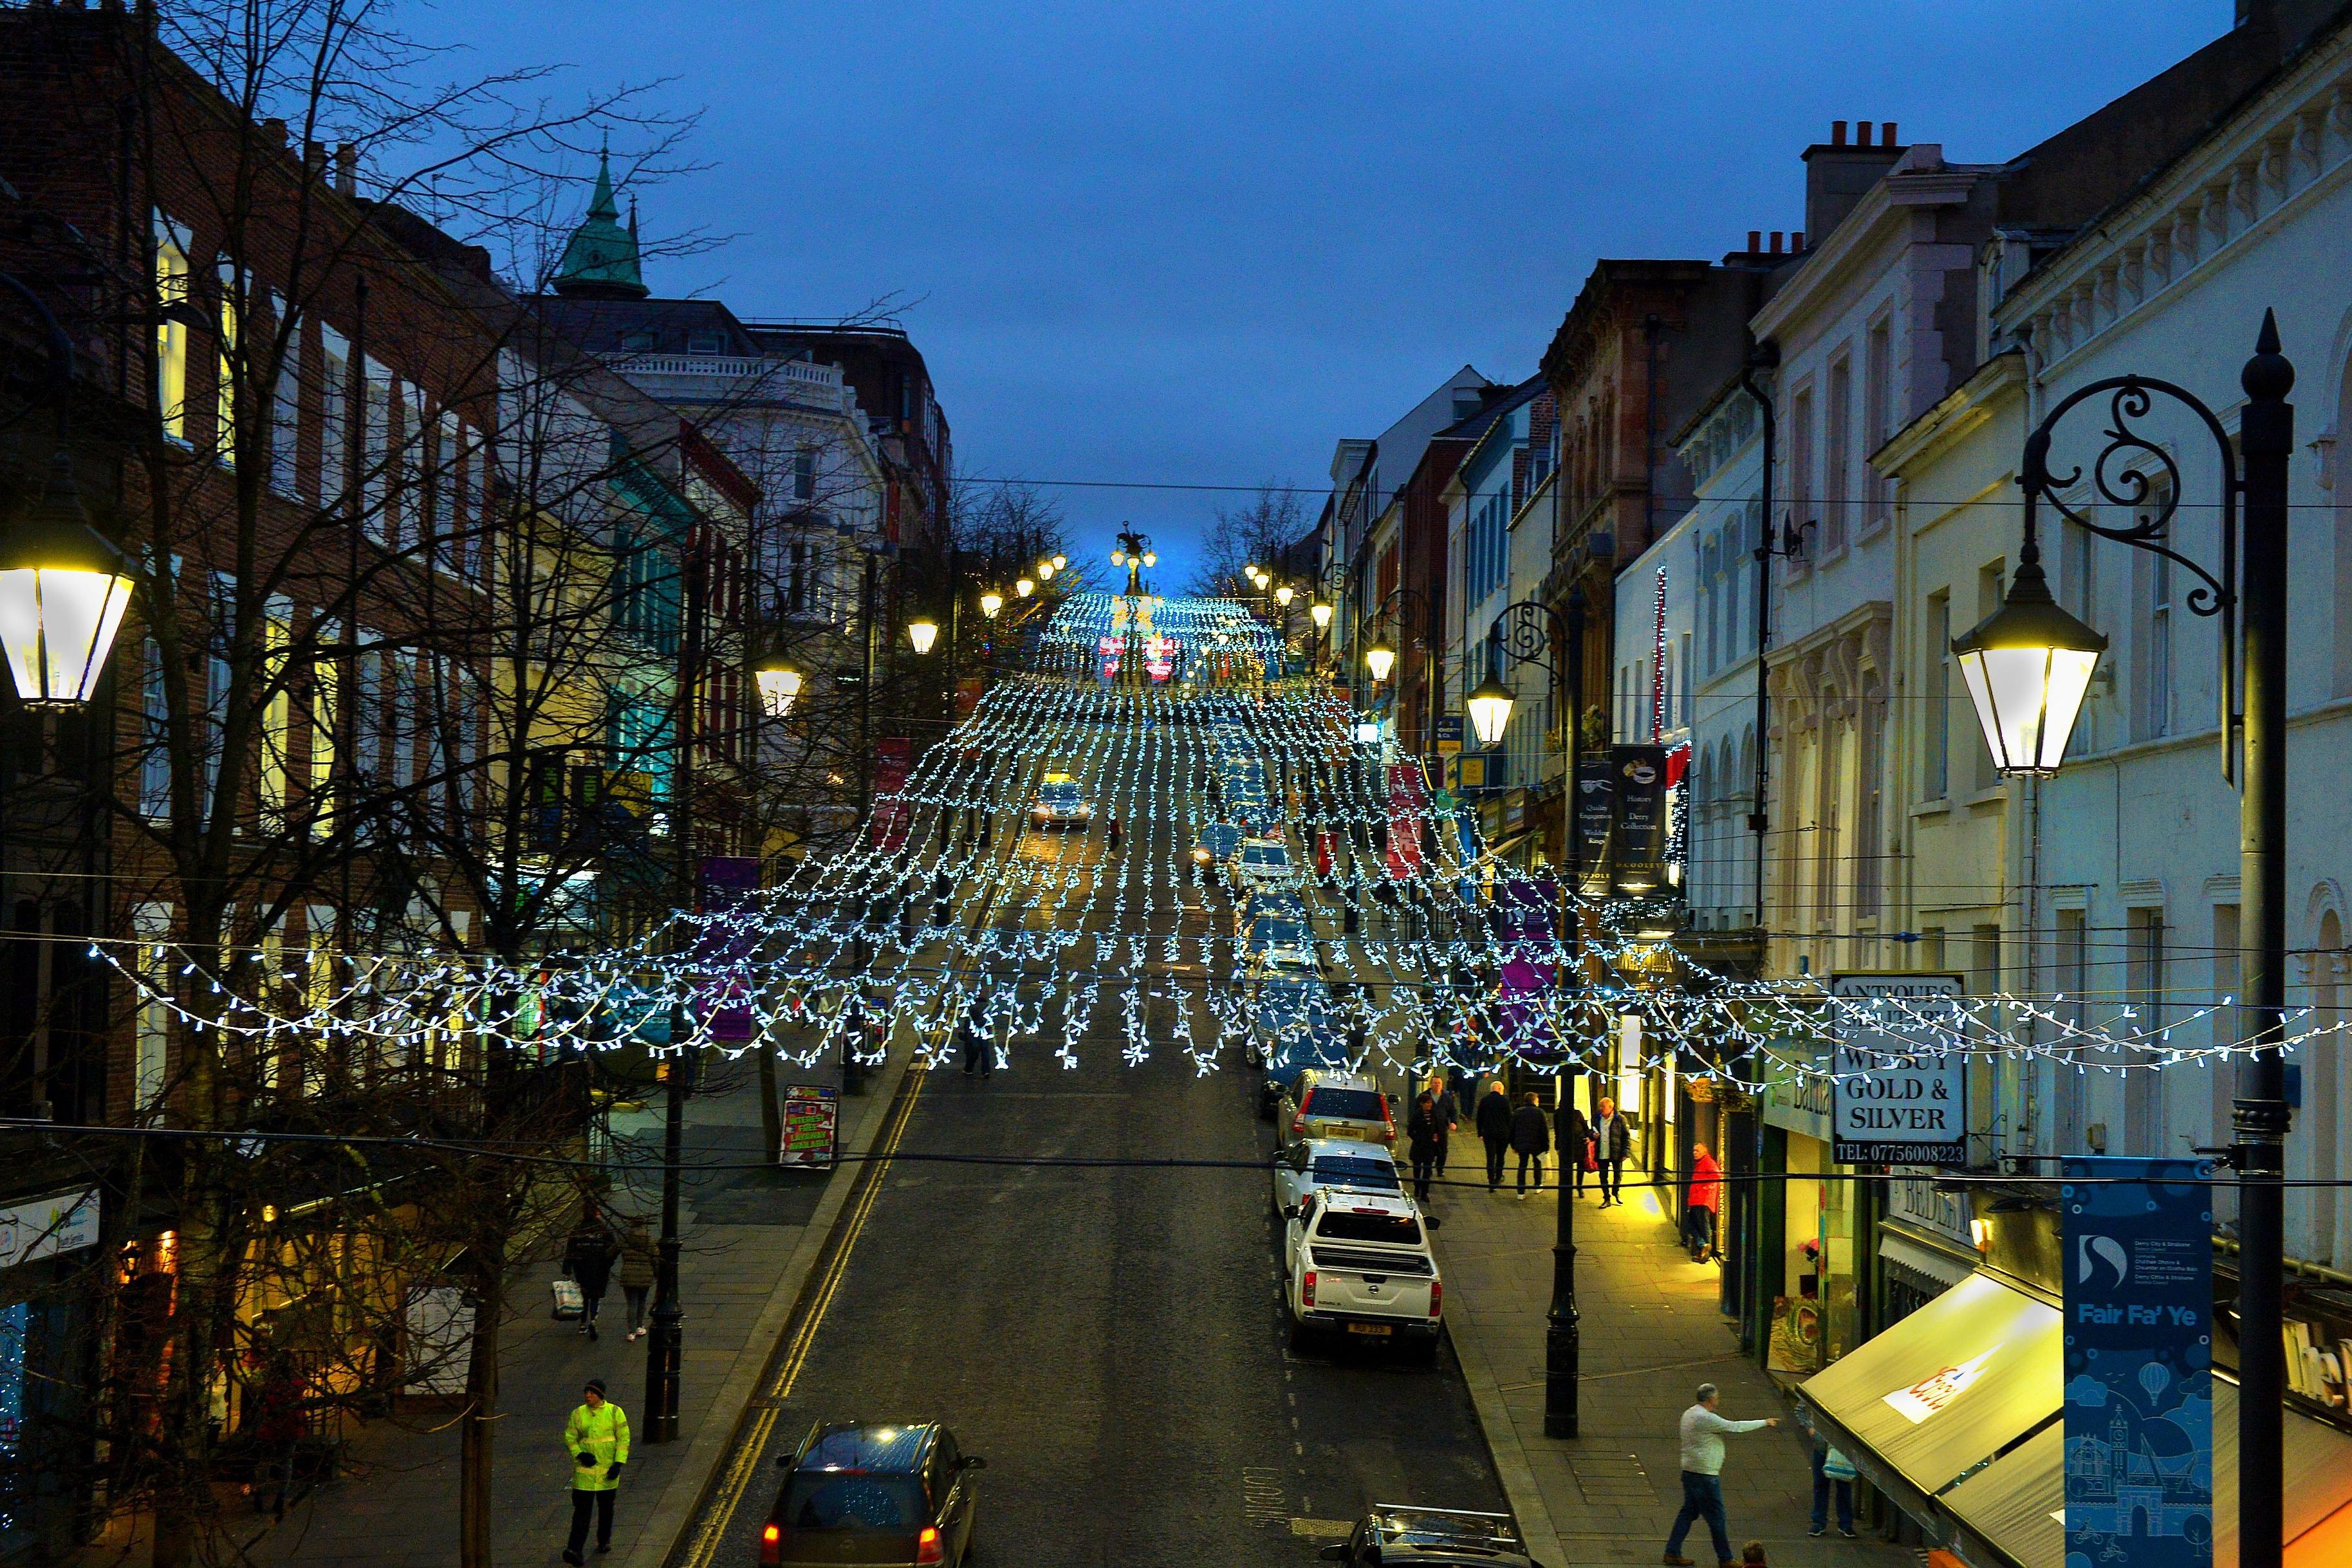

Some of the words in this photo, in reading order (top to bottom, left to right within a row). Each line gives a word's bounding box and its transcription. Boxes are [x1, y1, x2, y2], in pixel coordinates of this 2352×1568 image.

[1846, 1048, 1885, 1069] WE
[1846, 1078, 1923, 1099] GOLD
[1932, 1079, 1950, 1100] &
[1849, 1107, 1947, 1130] SILVER
[1837, 1144, 1868, 1161] TEL:
[2078, 1304, 2122, 1324] Fair
[2167, 1305, 2197, 1326] Ye
